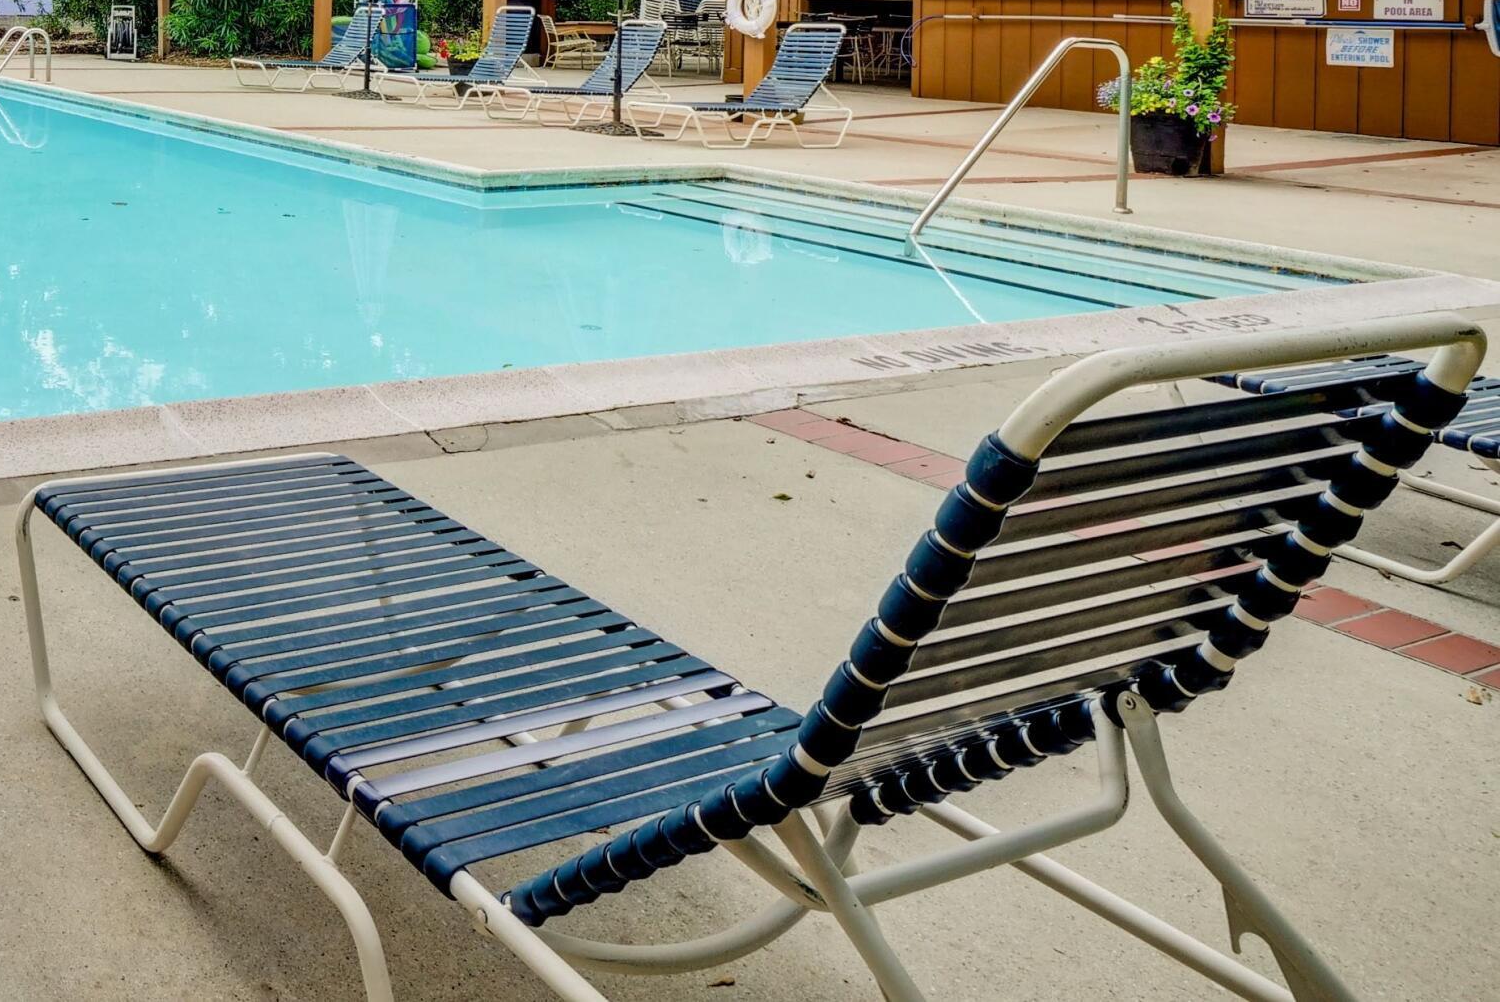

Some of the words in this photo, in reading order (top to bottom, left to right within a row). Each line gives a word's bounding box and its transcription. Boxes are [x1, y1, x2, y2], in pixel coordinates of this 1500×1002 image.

[1384, 7, 1407, 16] POOL
[1409, 8, 1433, 16] AREA
[1358, 37, 1390, 45] SHOWER
[1340, 45, 1379, 54] BEFORE
[1331, 54, 1366, 62] ENTERING
[1370, 55, 1390, 63] POOL
[850, 354, 911, 372] NO
